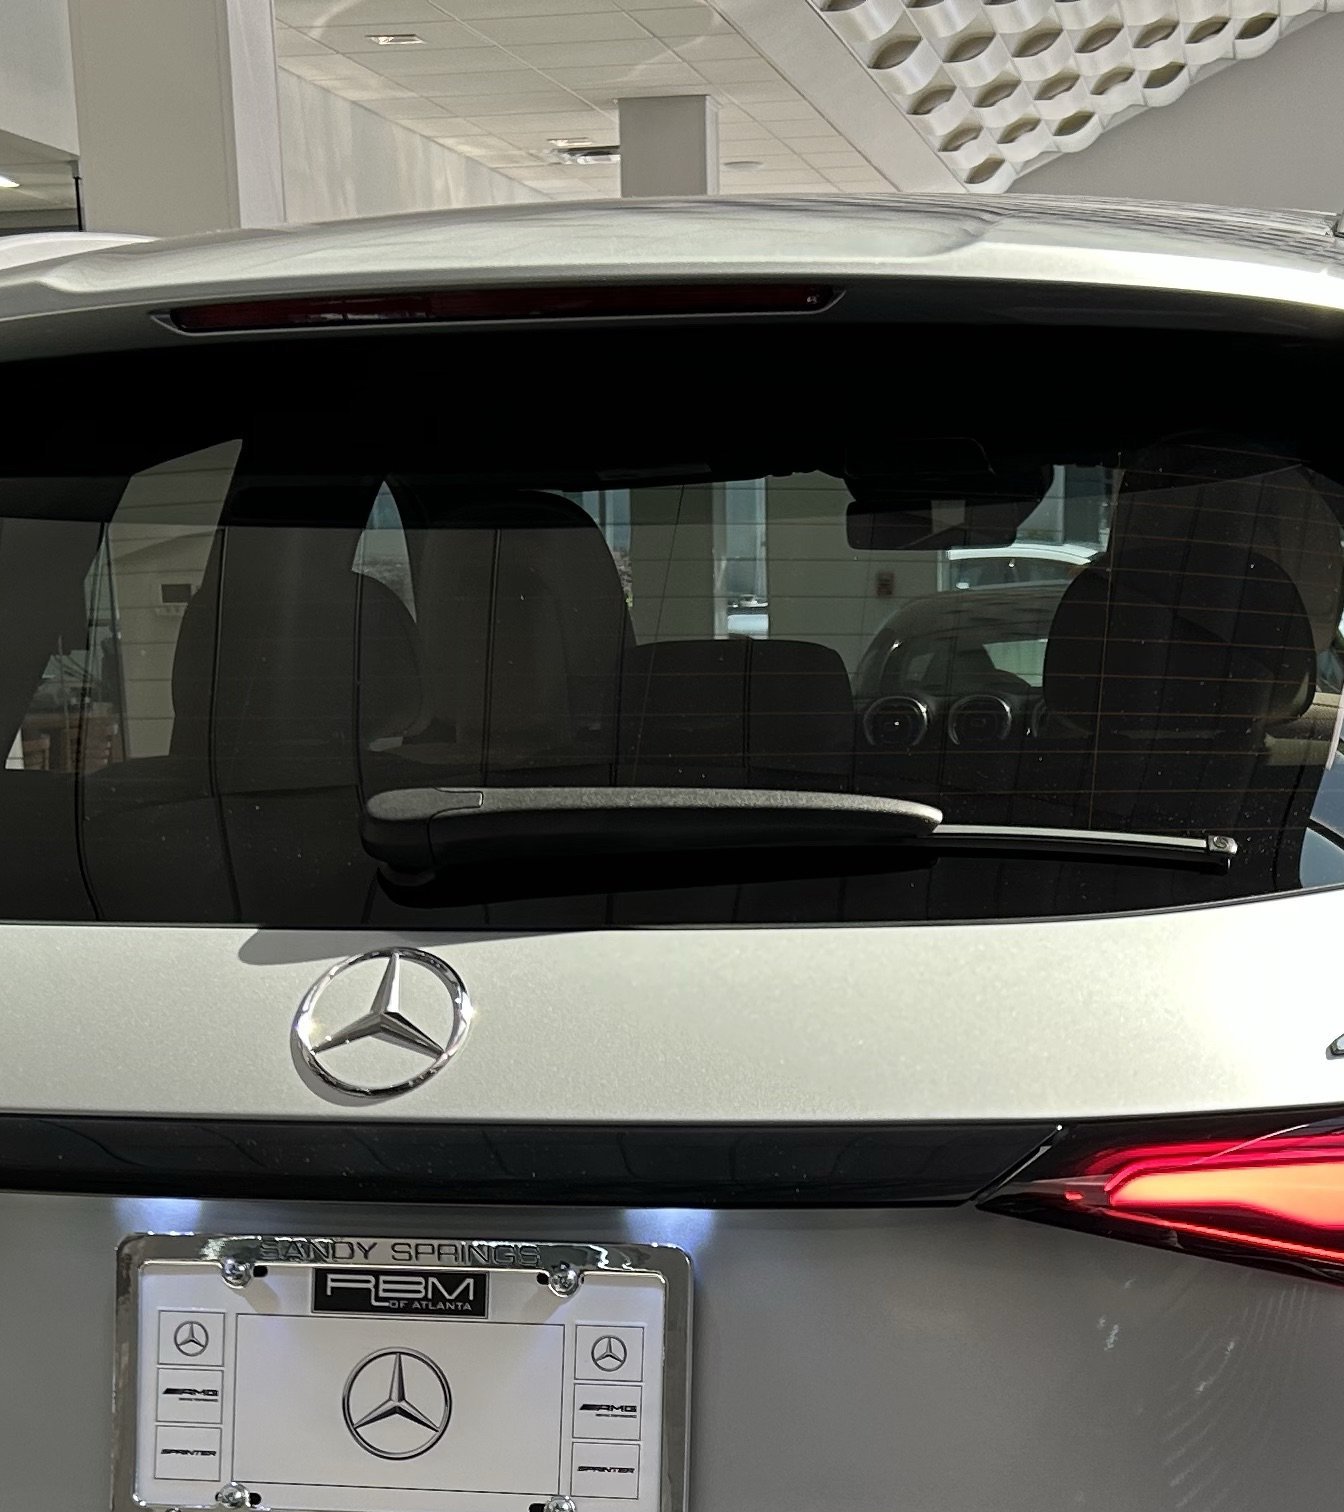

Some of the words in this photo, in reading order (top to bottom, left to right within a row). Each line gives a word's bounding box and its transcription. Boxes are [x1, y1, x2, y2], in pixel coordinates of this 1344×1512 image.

[258, 1238, 377, 1263] SANDY
[391, 1241, 541, 1267] SPRINGS
[326, 1273, 474, 1307] RBM
[388, 1299, 407, 1309] OF
[411, 1300, 472, 1311] ATLANTA
